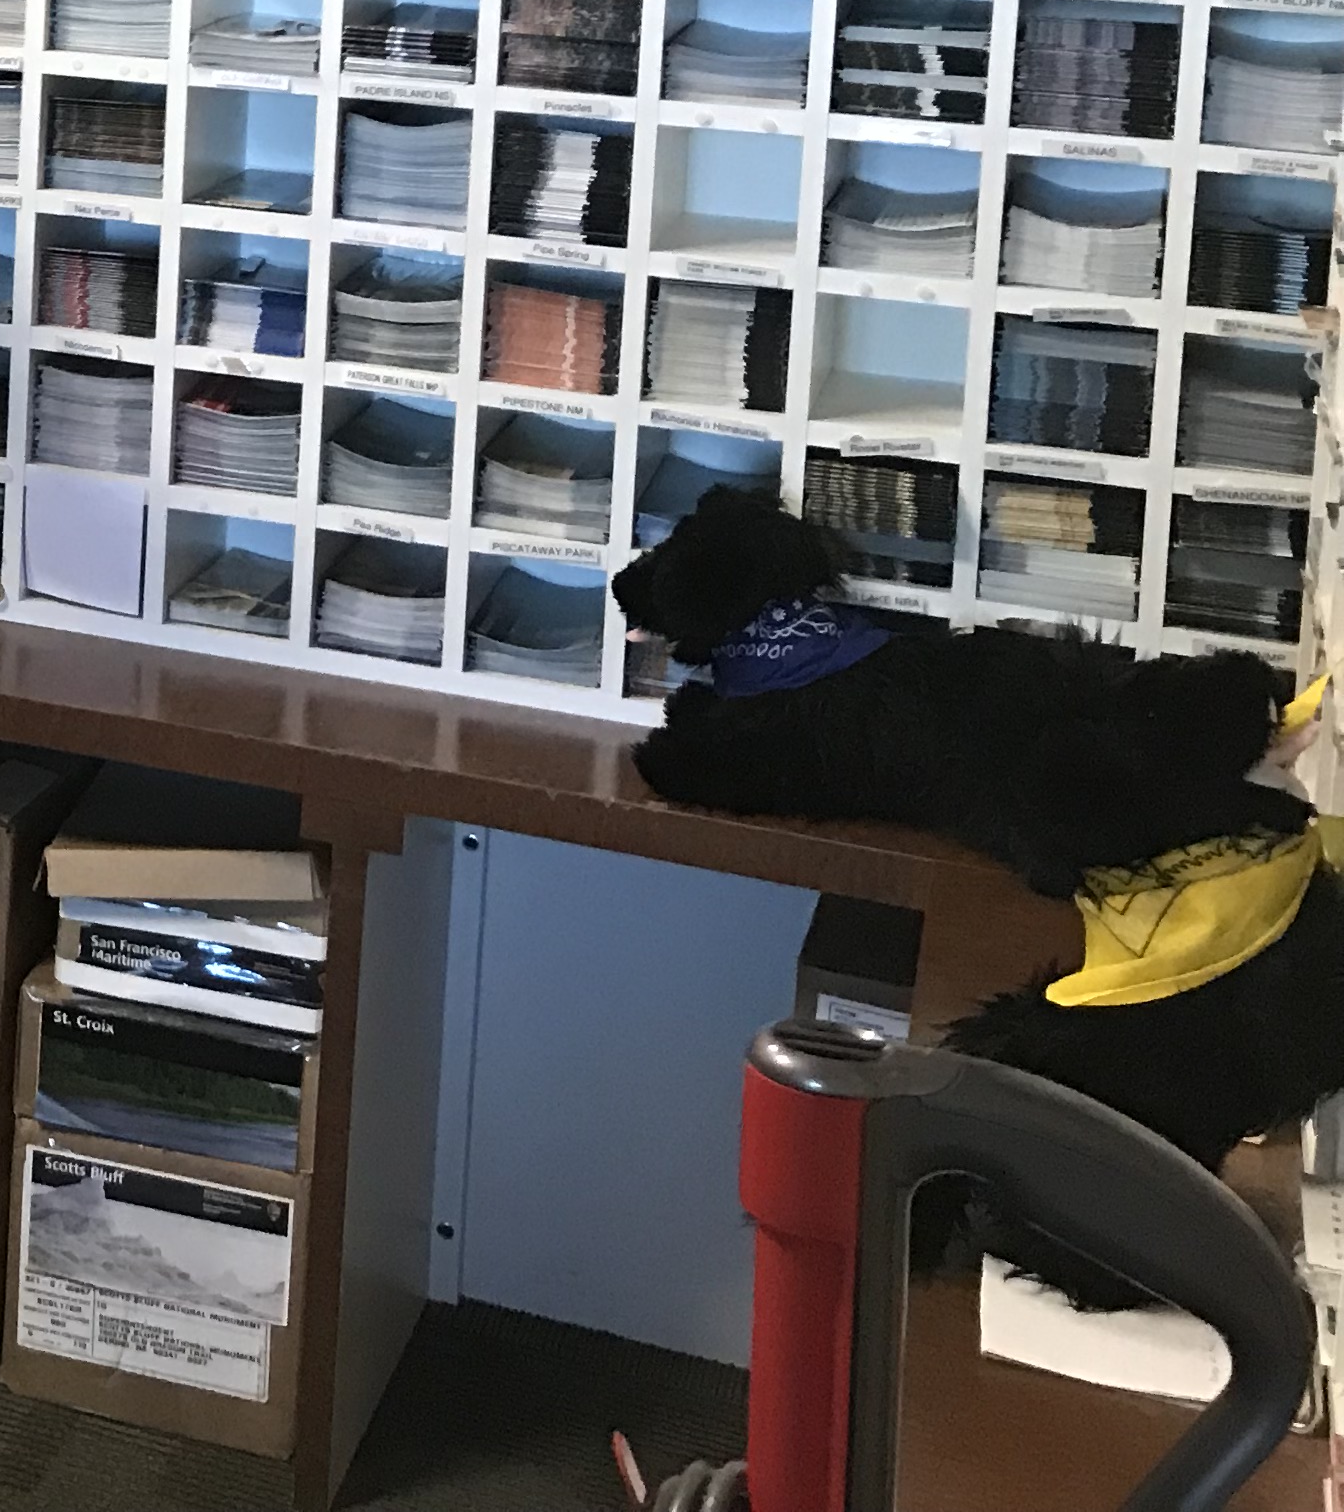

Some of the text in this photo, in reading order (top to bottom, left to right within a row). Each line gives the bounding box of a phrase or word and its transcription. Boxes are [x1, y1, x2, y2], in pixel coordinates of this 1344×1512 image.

[354, 85, 392, 97] PADRE
[393, 87, 433, 99] ISLAND
[544, 100, 593, 113] Pinnacles
[1062, 143, 1118, 157] SALINAS
[532, 243, 590, 262] Pipe Spring
[502, 396, 584, 415] PIPESTONE NM
[1194, 488, 1288, 504] SHENANDOAH
[353, 518, 372, 531] Pea
[491, 541, 594, 558] PISCATAWAY PARK
[859, 591, 920, 608] LAKE NRA
[90, 933, 182, 963] San Francisco
[92, 947, 152, 971] Maritime
[52, 1009, 115, 1036] St. Croix
[44, 1155, 125, 1186] Scotts Bluff
